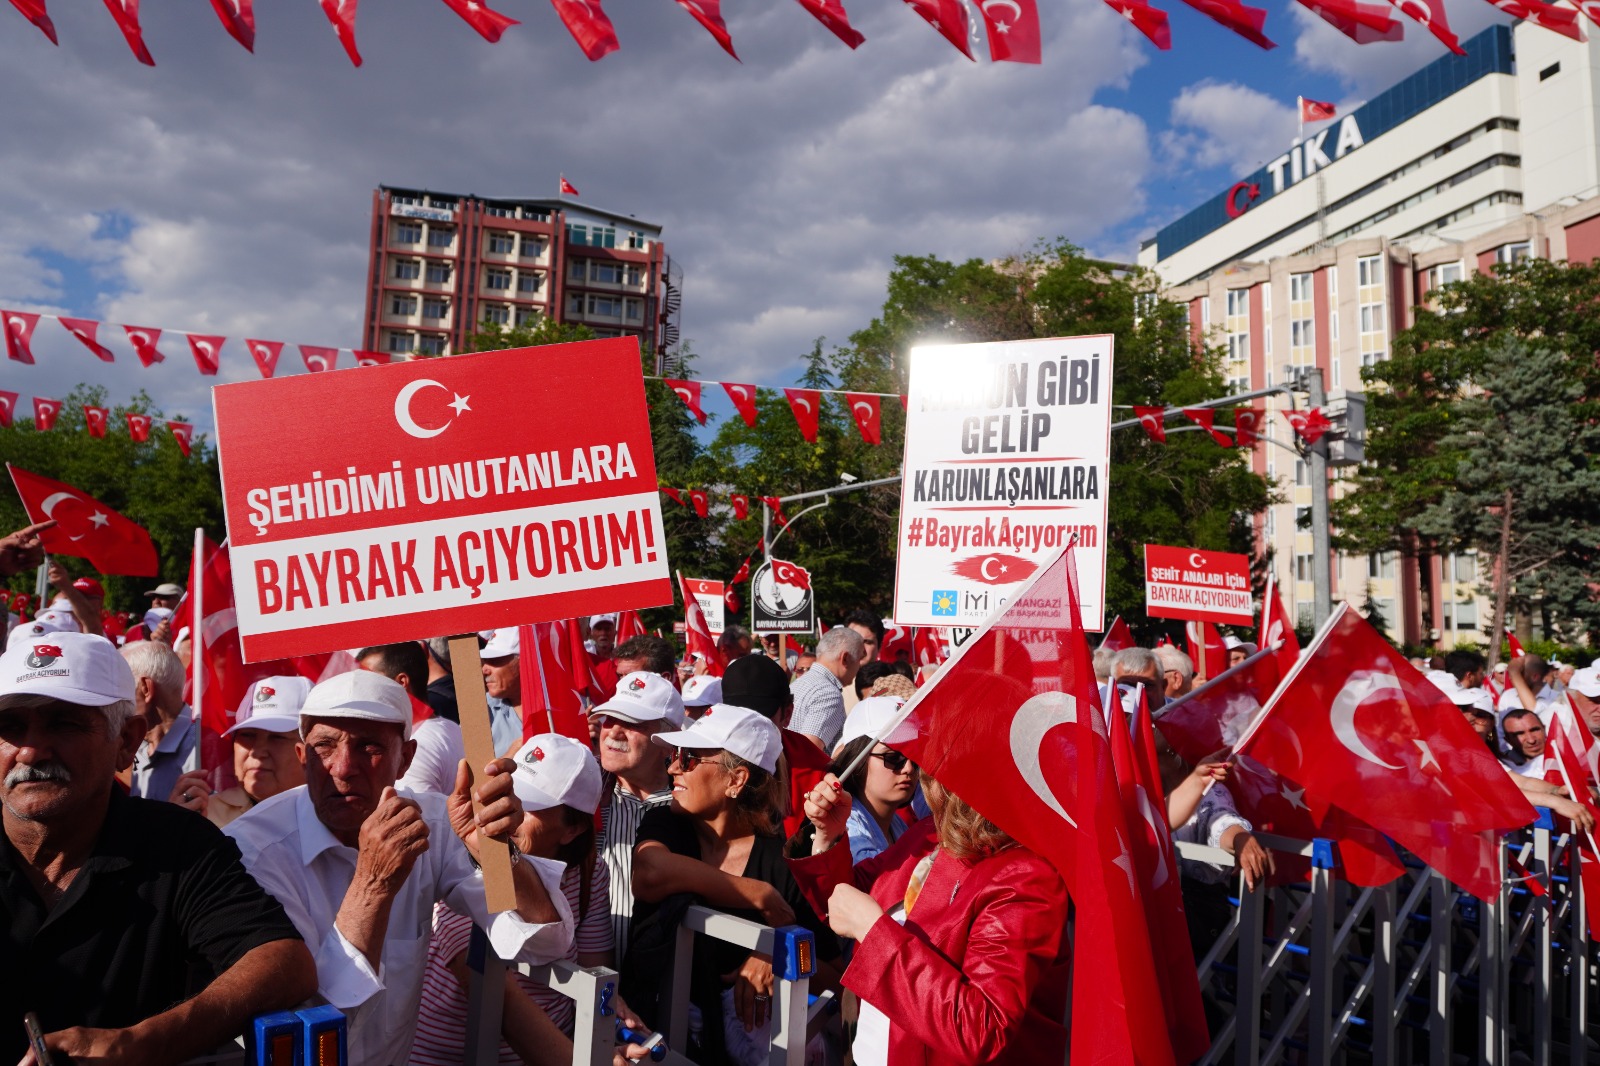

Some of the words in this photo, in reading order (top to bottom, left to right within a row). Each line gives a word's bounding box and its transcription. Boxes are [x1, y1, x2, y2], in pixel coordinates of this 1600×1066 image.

[1267, 114, 1364, 194] TİKA
[1036, 353, 1100, 406] GİBİ
[961, 409, 1051, 455] GELİP
[246, 460, 406, 536] ŞEHİDİMİ
[414, 442, 637, 505] UNUTANLARA
[913, 465, 1099, 506] KARUNLAŞANLARA
[253, 538, 424, 616] BAYRAK
[433, 508, 658, 599] AÇIYORUM!
[1151, 566, 1181, 581] ŞEHİT
[1182, 570, 1224, 586] ANALARI
[1225, 572, 1246, 590] İÇİN
[964, 590, 988, 610] İYİ
[1151, 586, 1192, 604] BAYRAK
[1194, 590, 1250, 609] AÇIYORUM!
[756, 620, 777, 628] BAYRAK
